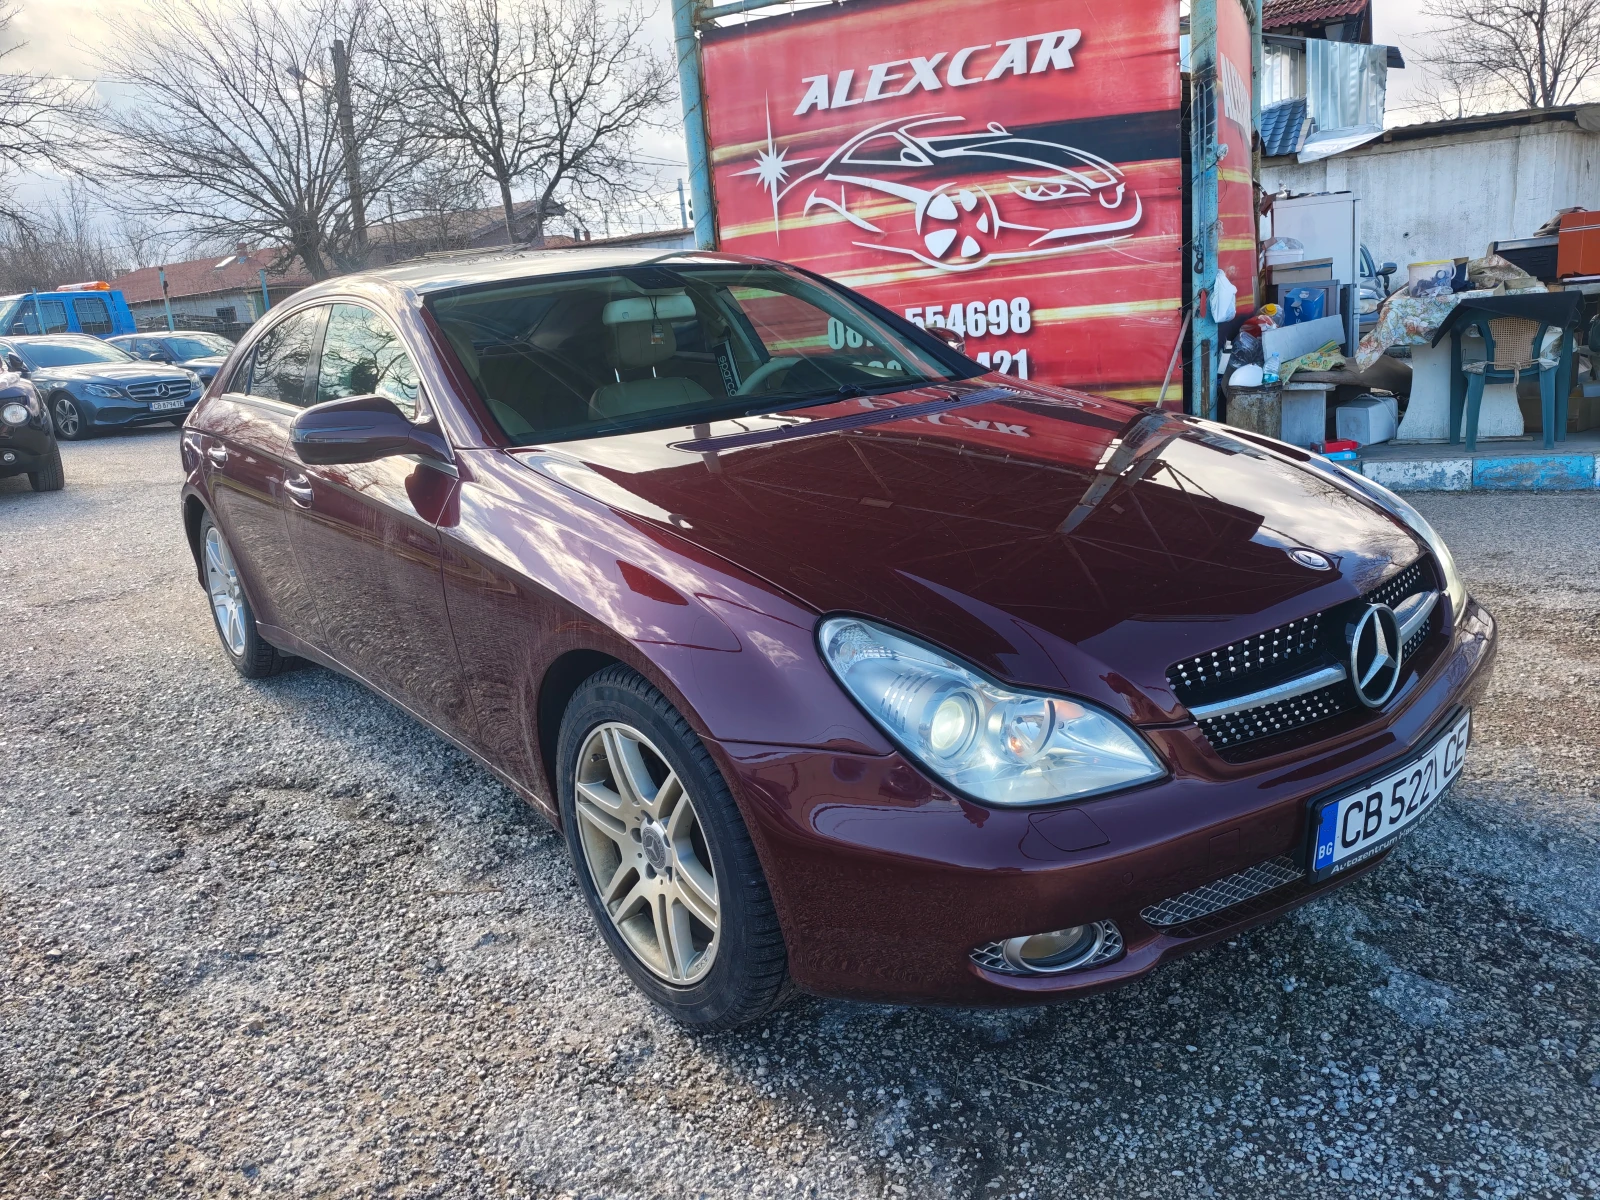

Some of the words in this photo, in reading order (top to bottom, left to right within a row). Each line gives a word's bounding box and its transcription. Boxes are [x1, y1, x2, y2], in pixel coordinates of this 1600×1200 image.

[793, 29, 1082, 116] ALEXCAR
[719, 355, 737, 396] sparco
[1341, 791, 1384, 849] CB
[1389, 754, 1438, 825] 5221
[1443, 721, 1467, 779] CE
[1318, 842, 1333, 860] BG
[1330, 836, 1398, 874] Autozentrum
